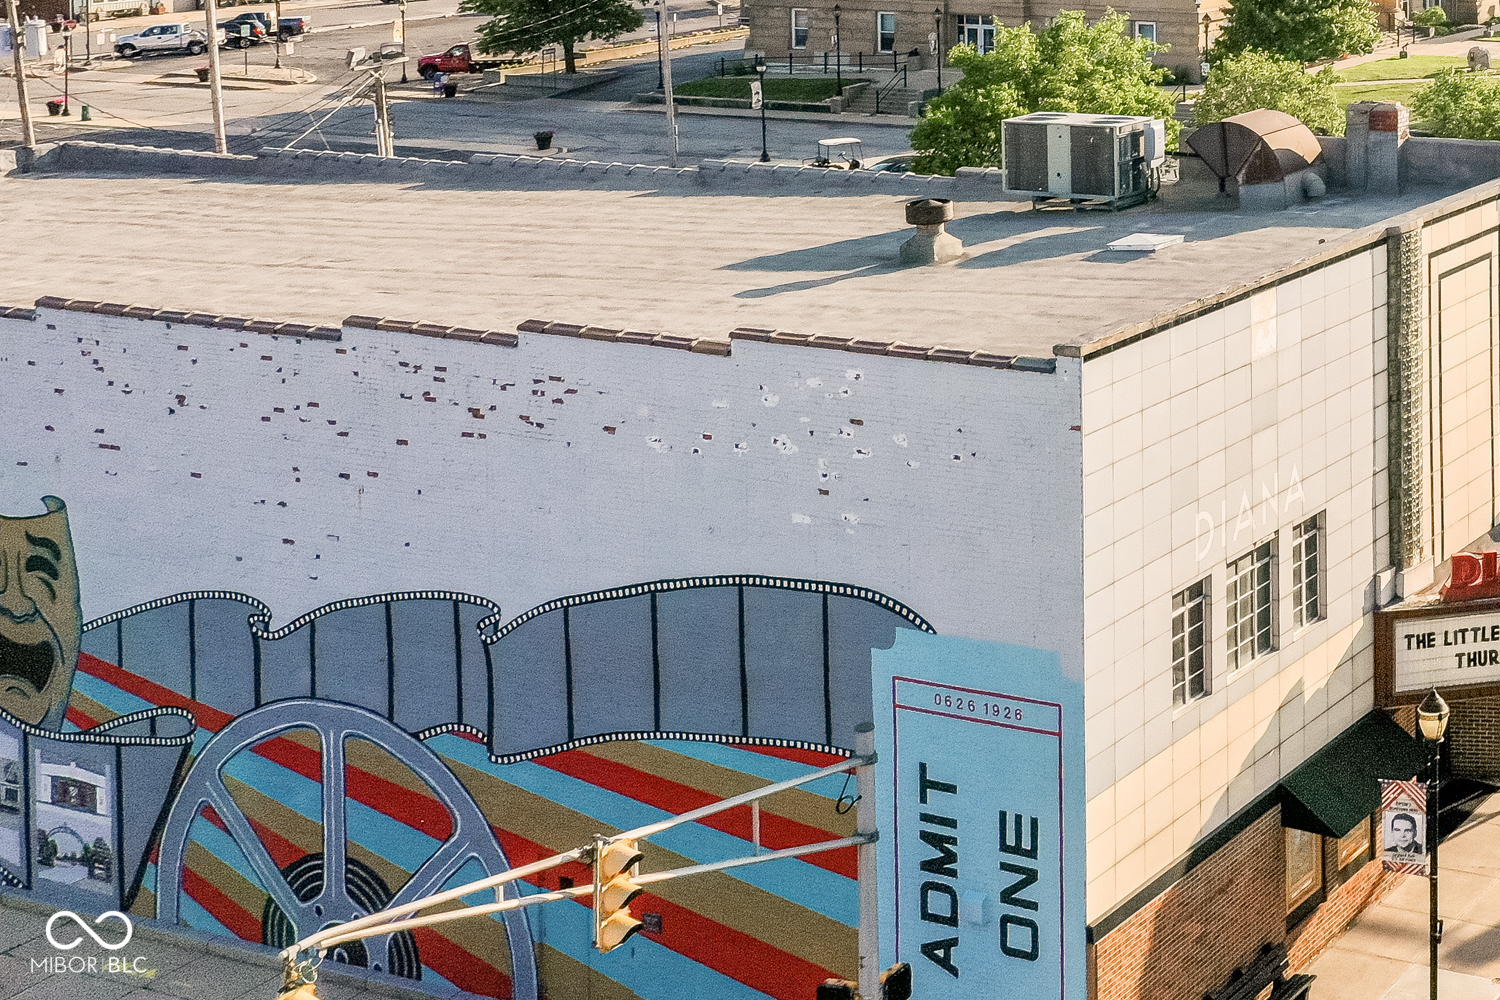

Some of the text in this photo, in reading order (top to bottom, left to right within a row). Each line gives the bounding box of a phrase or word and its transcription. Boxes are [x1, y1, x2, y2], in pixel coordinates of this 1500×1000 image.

[1195, 462, 1306, 562] DIANA
[1404, 632, 1436, 650] THE
[1443, 625, 1500, 646] LITTLE
[1455, 650, 1500, 669] THUR
[934, 693, 1022, 721] 0626 1926
[919, 762, 959, 979] ADMIT
[999, 810, 1039, 962] ONE
